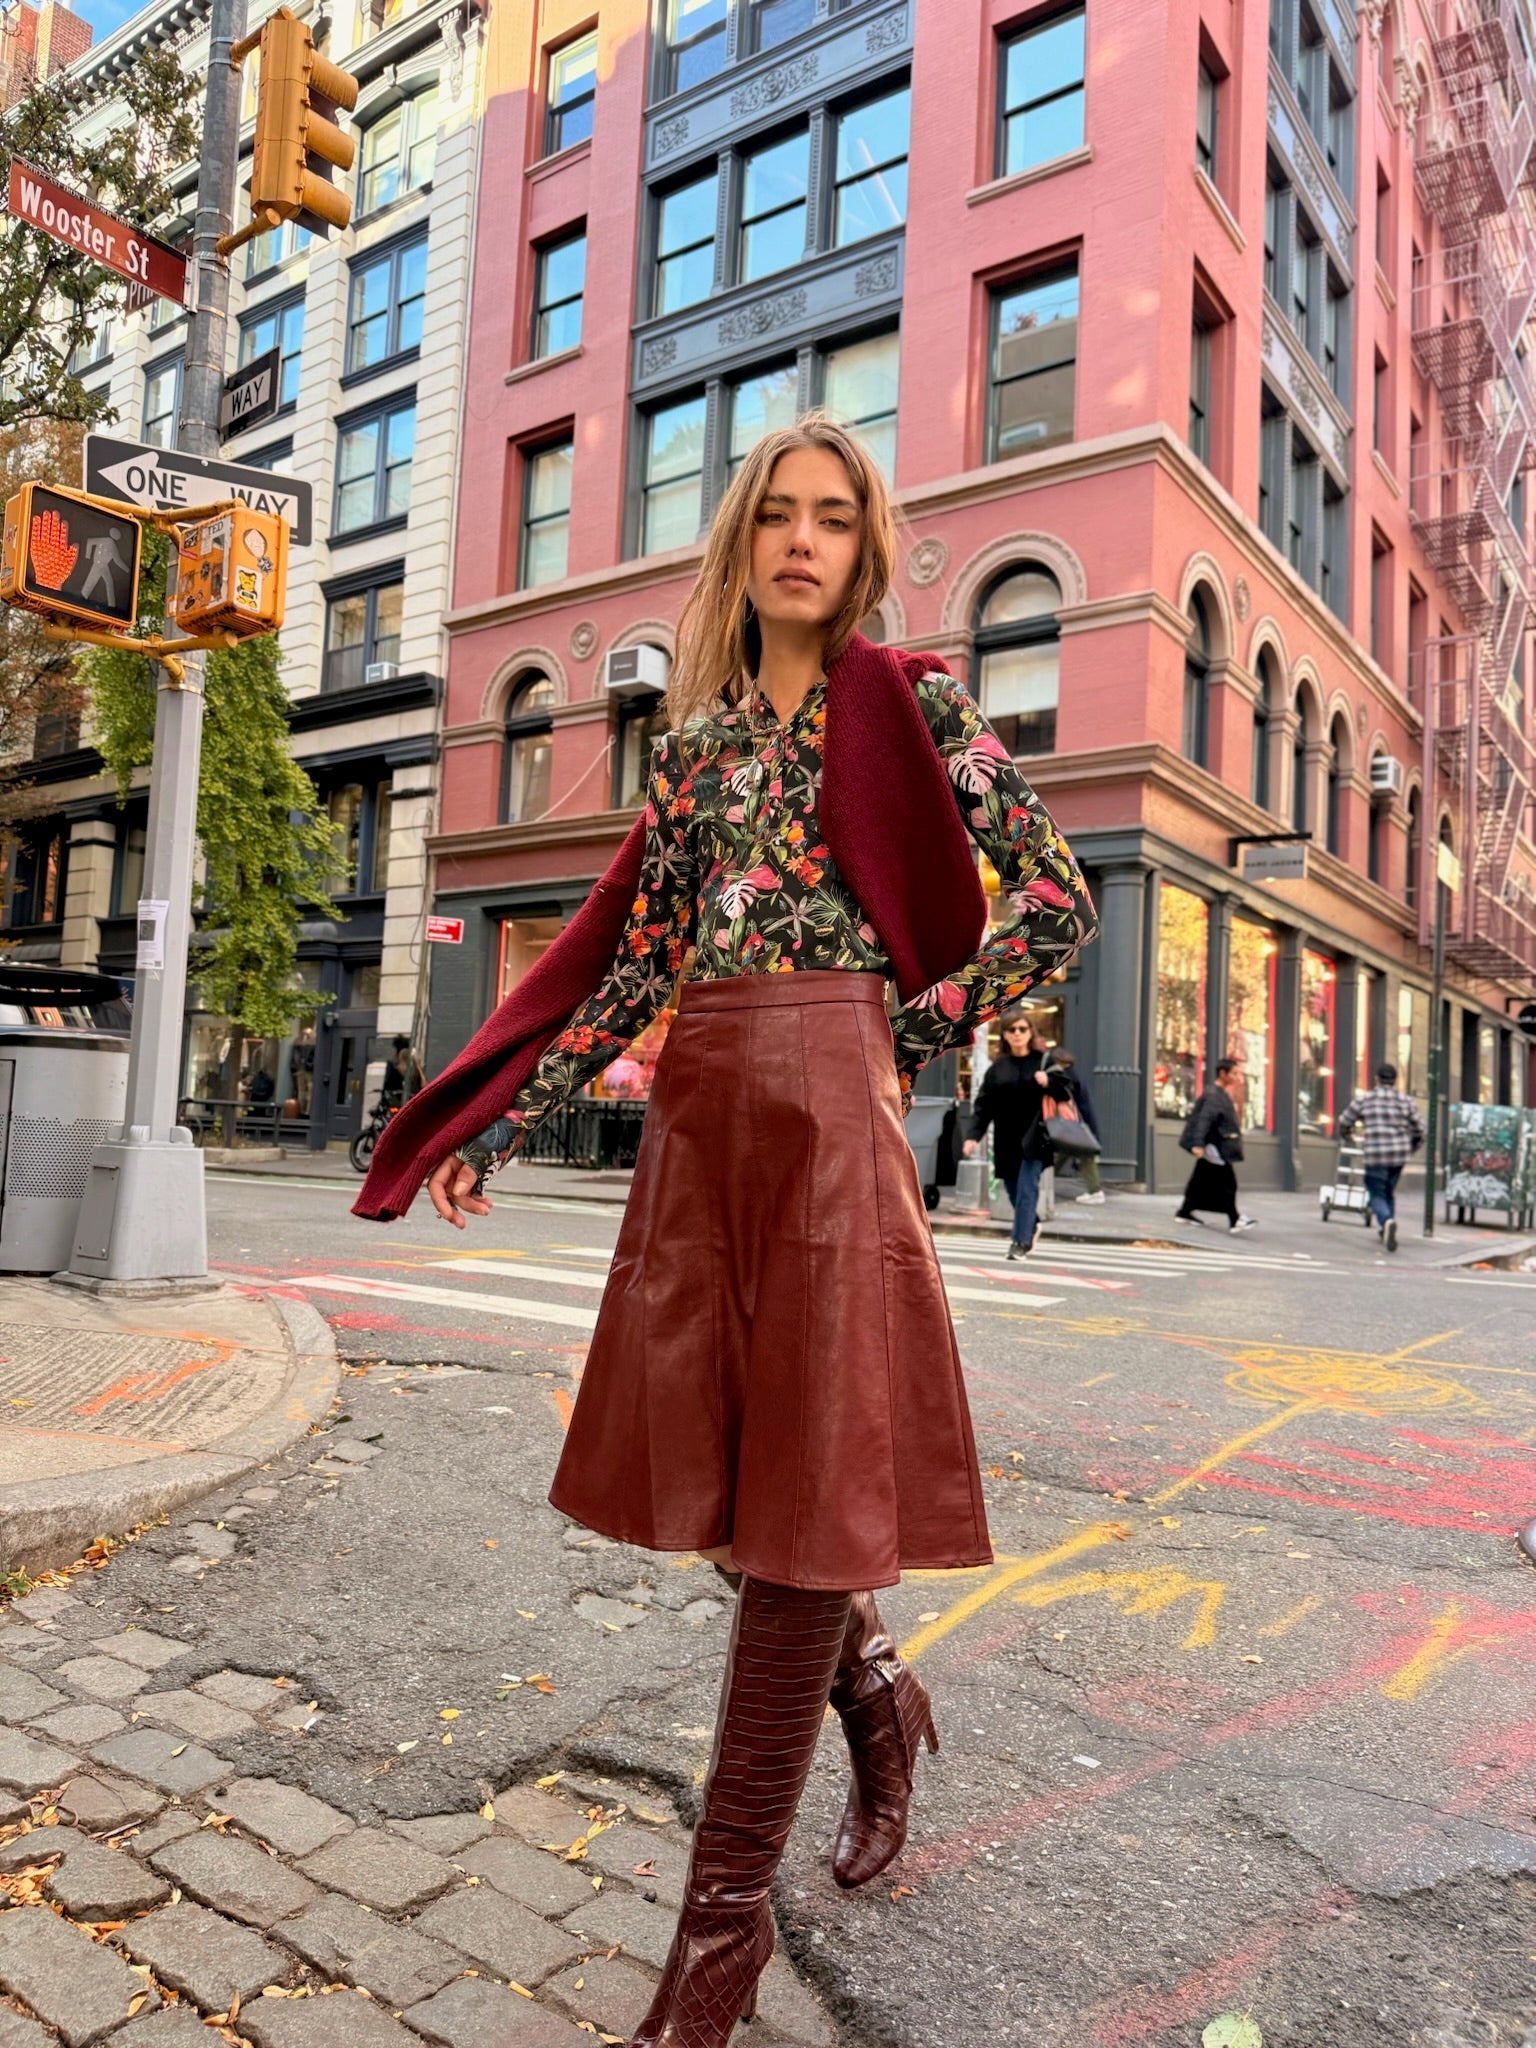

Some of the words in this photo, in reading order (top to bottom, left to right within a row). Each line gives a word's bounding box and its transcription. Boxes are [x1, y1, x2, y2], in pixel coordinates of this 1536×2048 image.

[20, 176, 116, 260] Wooster
[125, 239, 149, 280] St
[232, 376, 264, 417] WAY
[126, 466, 187, 502] ONE
